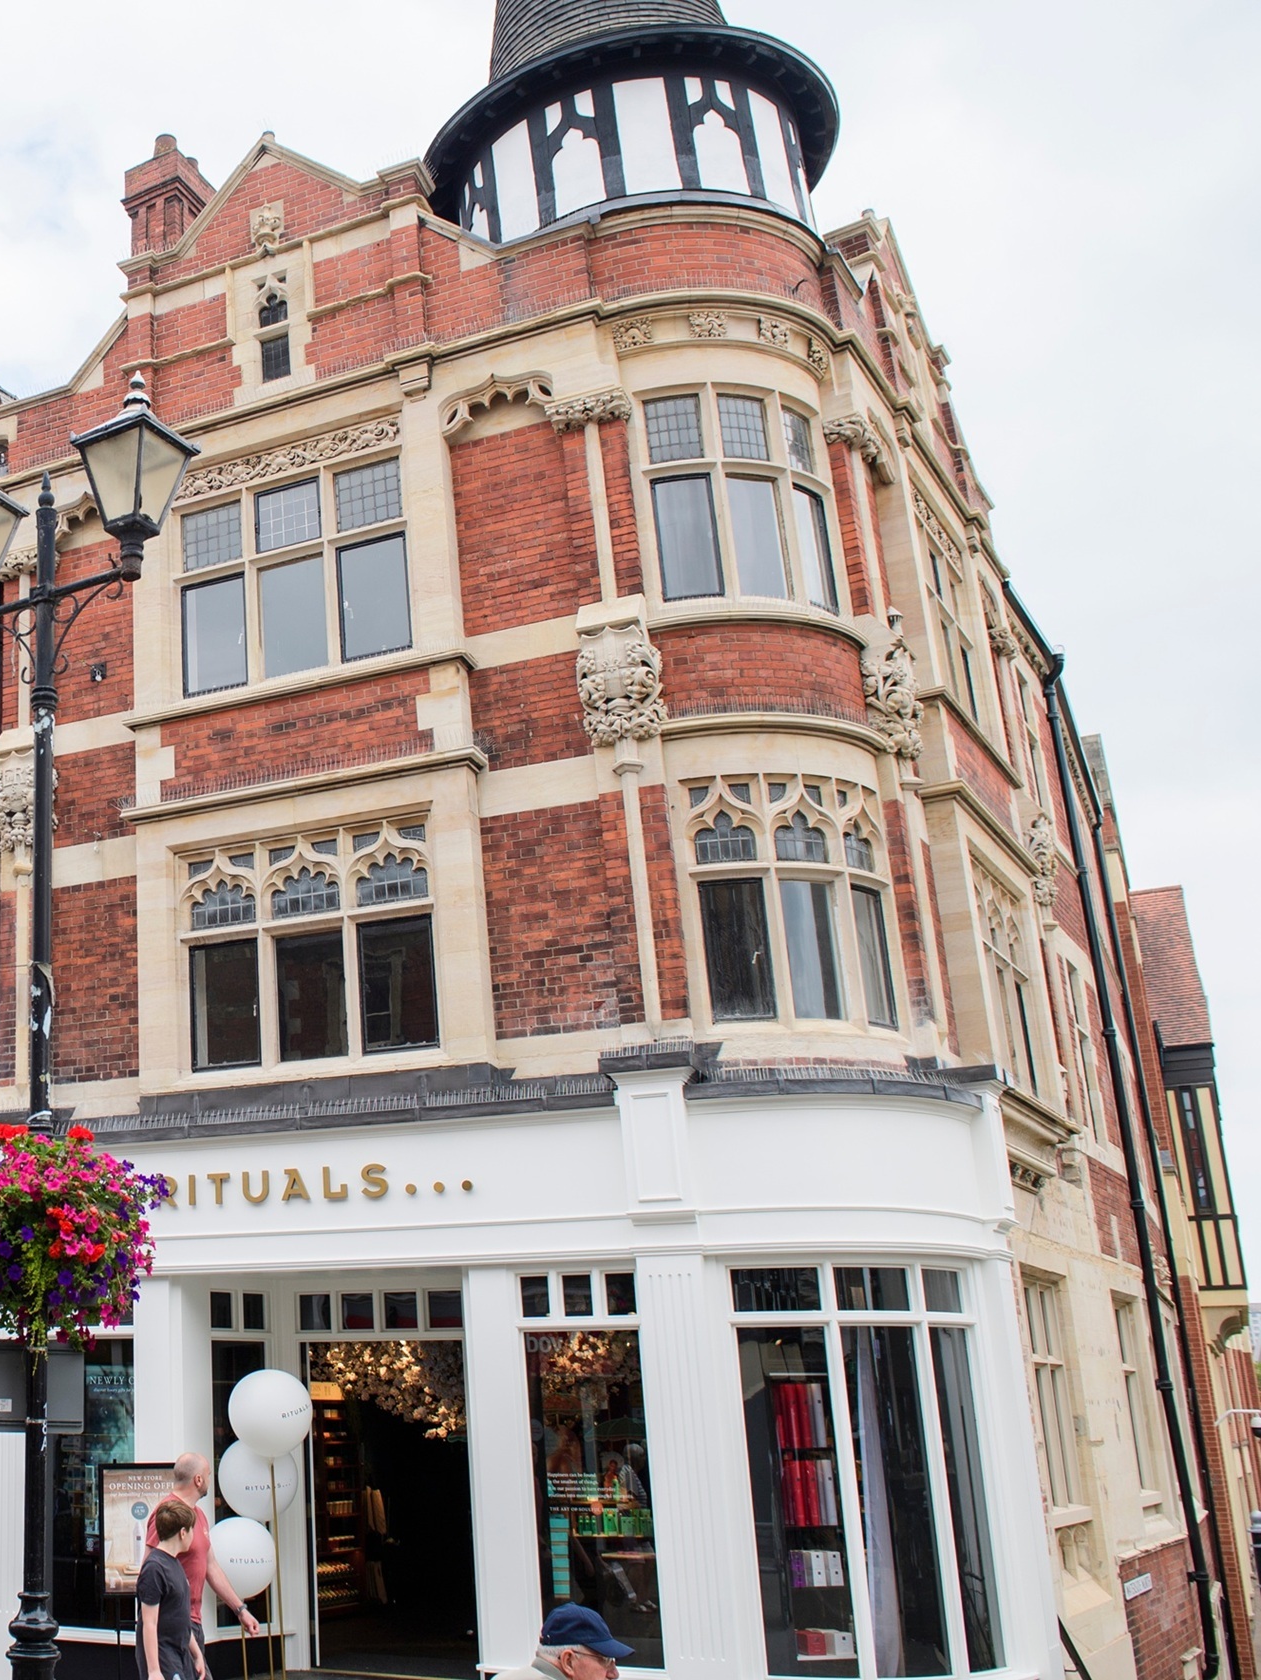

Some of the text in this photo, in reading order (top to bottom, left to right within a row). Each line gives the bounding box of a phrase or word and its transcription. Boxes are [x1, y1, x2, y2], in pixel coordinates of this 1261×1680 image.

[90, 1376, 125, 1385] NEWLY
[109, 1481, 174, 1490] OPENING OFF
[245, 1483, 291, 1491] RITUAS...
[229, 1557, 273, 1565] RITUALS...
